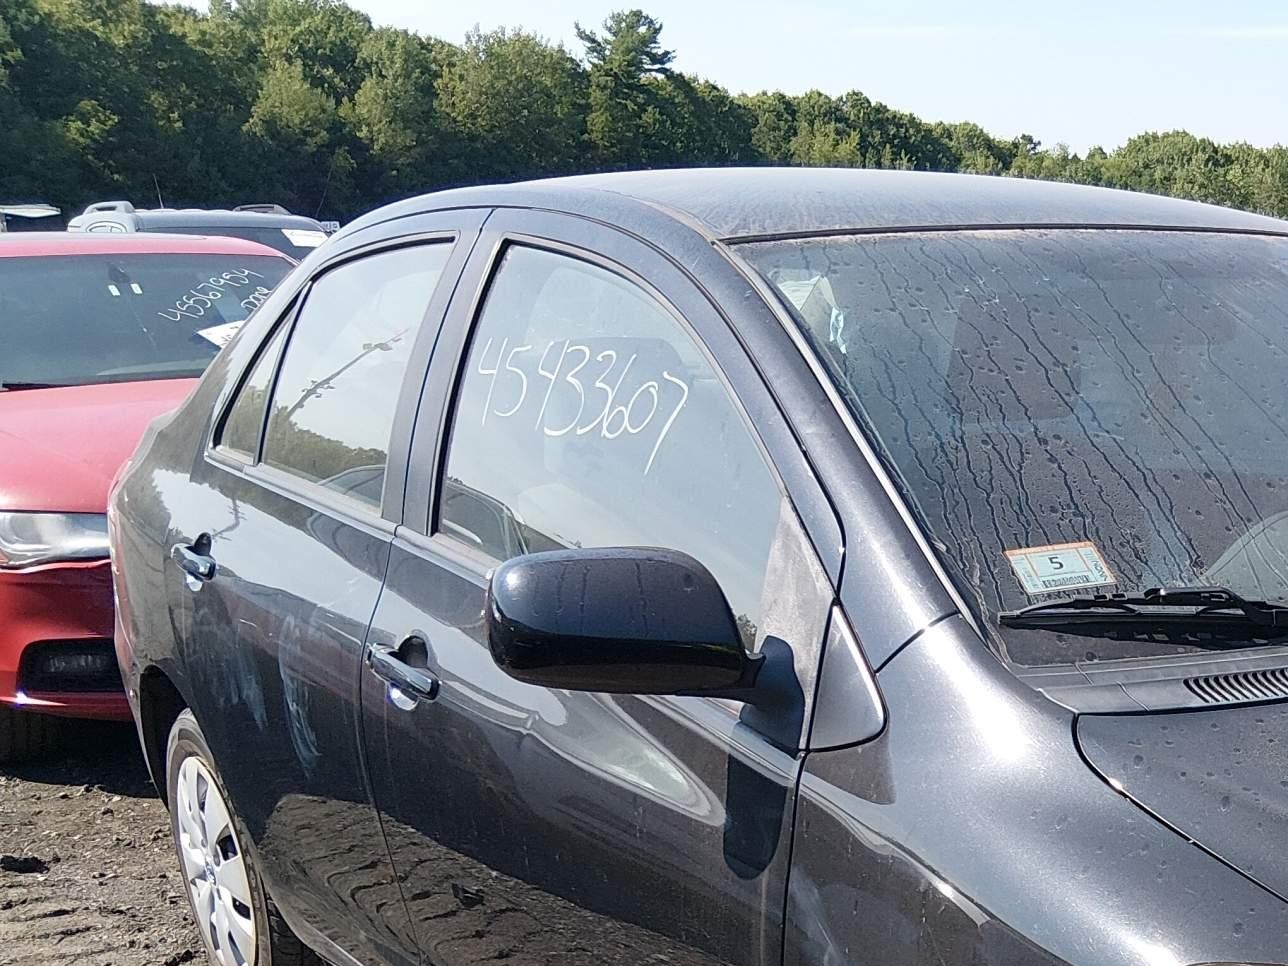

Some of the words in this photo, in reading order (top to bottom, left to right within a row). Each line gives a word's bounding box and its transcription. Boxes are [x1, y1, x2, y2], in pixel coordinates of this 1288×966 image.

[157, 267, 264, 322] 45567954
[478, 337, 689, 476] 45433607
[1047, 556, 1064, 570] 5
